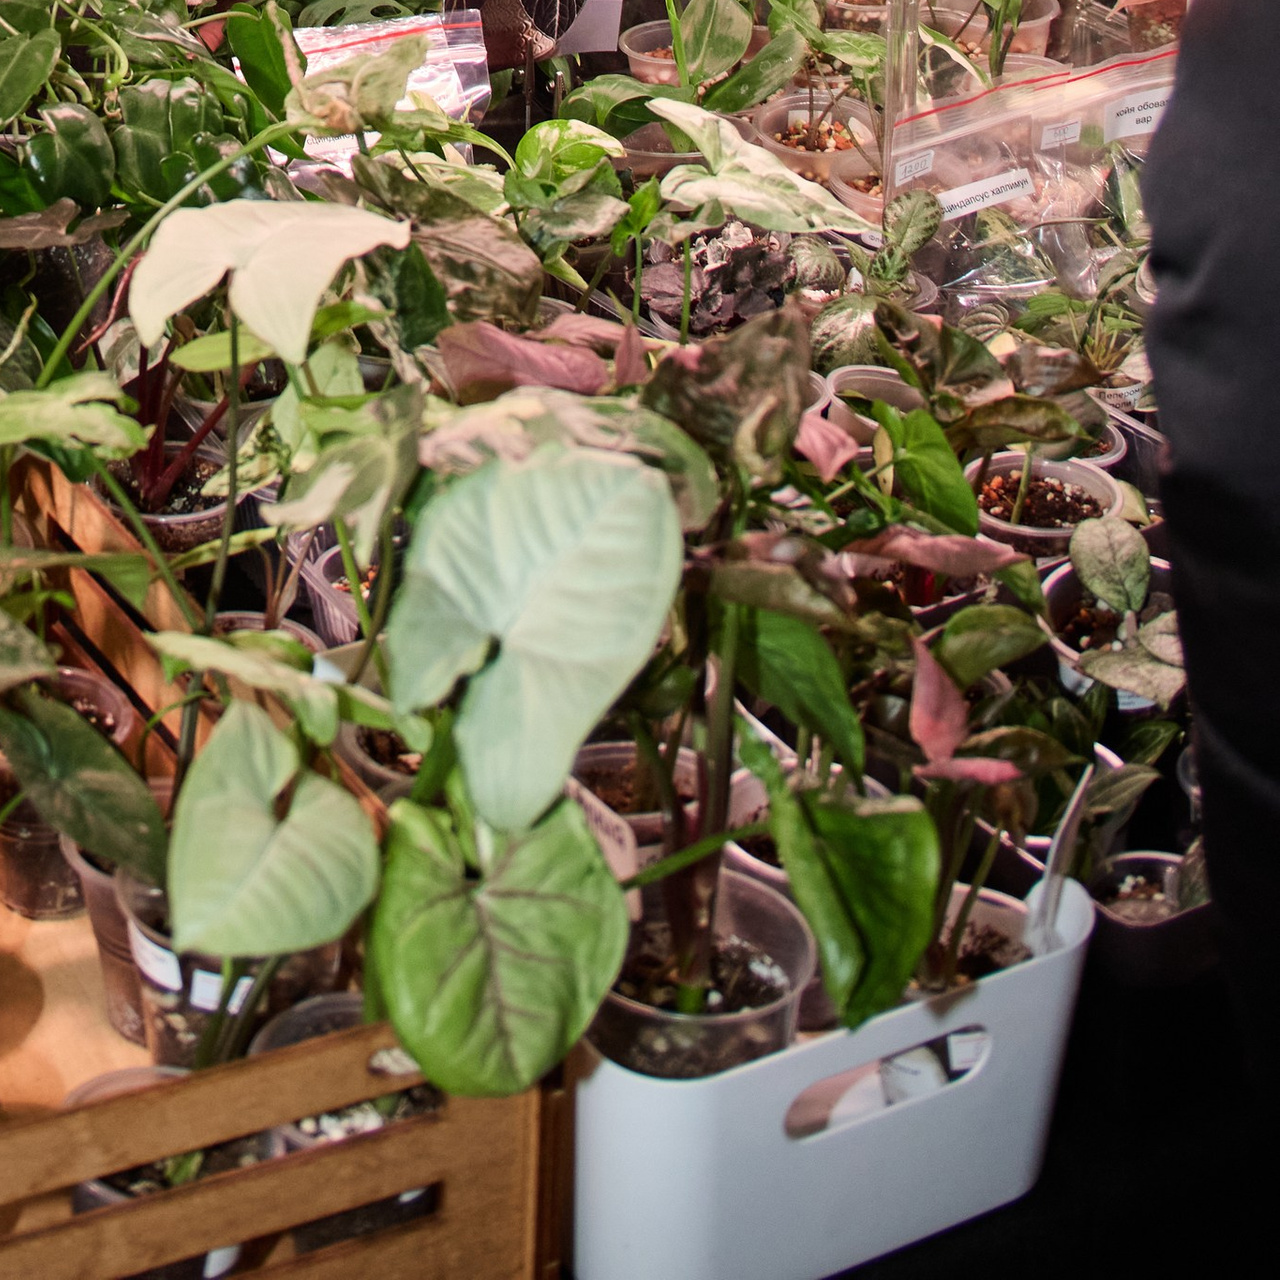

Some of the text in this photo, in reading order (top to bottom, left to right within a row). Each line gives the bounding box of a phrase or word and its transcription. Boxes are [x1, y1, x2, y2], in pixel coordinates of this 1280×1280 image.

[1115, 106, 1136, 118] хойя
[1135, 115, 1153, 125] вар
[990, 178, 1030, 197] халлимун
[1098, 388, 1143, 400] Пепером
